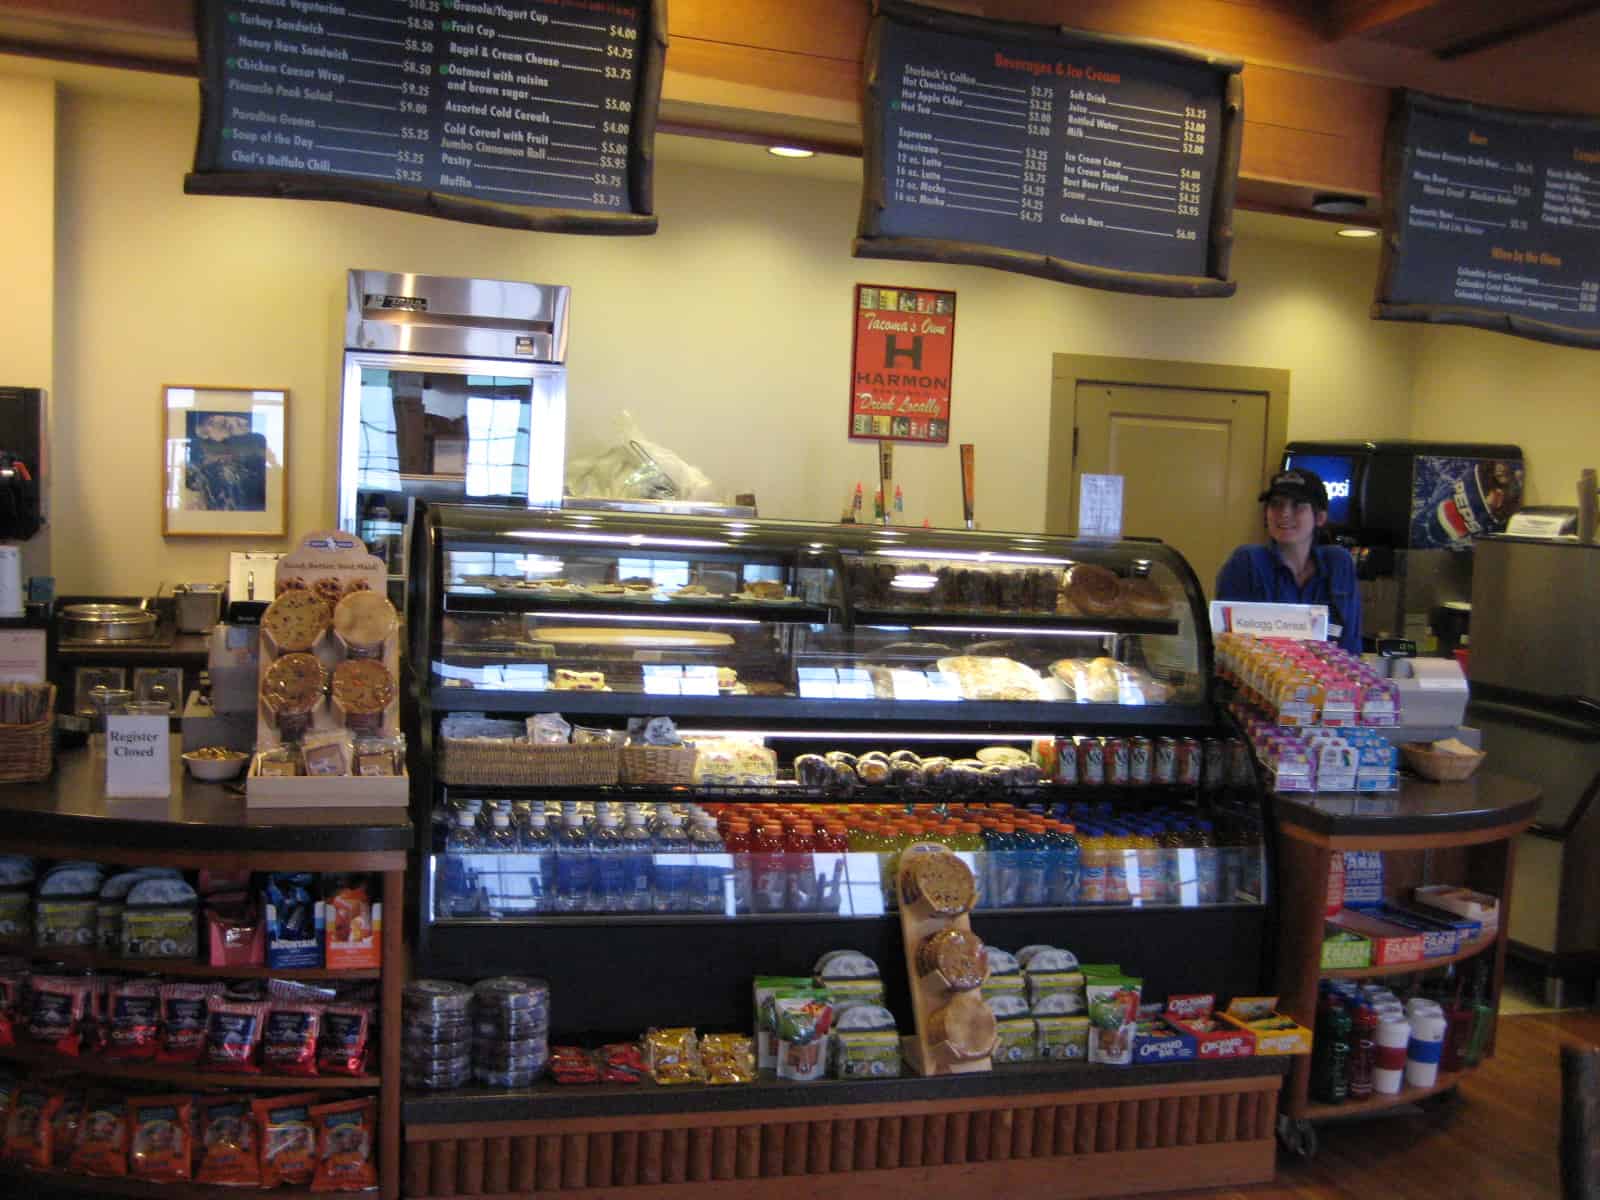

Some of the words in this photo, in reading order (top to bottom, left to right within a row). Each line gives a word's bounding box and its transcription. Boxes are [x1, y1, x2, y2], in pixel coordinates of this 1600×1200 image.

[240, 13, 273, 29] Turkey
[276, 16, 324, 35] Sandwich
[530, 10, 549, 25] Cup
[610, 25, 637, 40] $4.00
[238, 36, 271, 52] Honey
[274, 40, 299, 54] Ham
[301, 43, 348, 61] Sandwich
[451, 21, 474, 34] Fruit
[476, 25, 496, 38] Cup
[607, 46, 633, 60] $4.75
[450, 42, 479, 58] Bagel
[481, 47, 489, 57] &
[492, 48, 523, 63] Cream
[526, 53, 560, 67] Cheese
[605, 66, 632, 80] $3.75
[237, 58, 277, 73] Chicken
[280, 64, 315, 78] Caesar
[318, 67, 345, 83] Wrap
[448, 64, 490, 79] Oatmeal
[493, 69, 514, 83] with
[516, 72, 549, 87] raisins
[950, 72, 976, 84] Coffee
[903, 76, 917, 87] Hot
[303, 87, 333, 102] Salad
[447, 80, 466, 92] and
[468, 82, 499, 97] brown
[502, 86, 529, 101] sugar
[902, 90, 916, 99] Hot
[918, 91, 940, 105] Apple
[942, 94, 963, 107] Cider
[1086, 92, 1106, 104] Drink
[232, 108, 276, 123] Paradise
[445, 100, 487, 116] Assorted
[490, 105, 511, 118] Cold
[514, 109, 550, 124] Cereals
[901, 102, 916, 112] Hot
[918, 105, 931, 115] Tea
[1066, 127, 1084, 138] Milk
[1096, 118, 1119, 131] Water
[232, 128, 257, 144] Soup
[260, 131, 272, 143] of
[274, 132, 291, 146] the
[293, 135, 314, 149] Day
[444, 122, 466, 135] Cold
[468, 126, 500, 140] Cereal
[503, 130, 524, 143] with
[526, 132, 549, 145] Fruit
[441, 137, 473, 151] Jumbo
[476, 142, 524, 157] Cinnamon
[527, 147, 546, 160] Roll
[307, 158, 331, 172] Chili
[442, 152, 472, 168] Pastry
[922, 156, 942, 168] Latte
[1065, 151, 1076, 161] Ice
[1077, 153, 1101, 165] Cream
[1103, 157, 1122, 168] Cone
[1064, 163, 1075, 173] Ice
[1077, 165, 1100, 177] Cream
[440, 174, 472, 188] Muffin
[920, 181, 946, 193] Mocha
[864, 312, 916, 333] Tacoma's
[922, 317, 947, 335] Own
[885, 333, 923, 370] H
[856, 372, 948, 390] HARMON
[856, 392, 896, 410] Drink
[898, 395, 941, 417] Locally
[111, 730, 159, 745] Register
[114, 746, 154, 758] Closed
